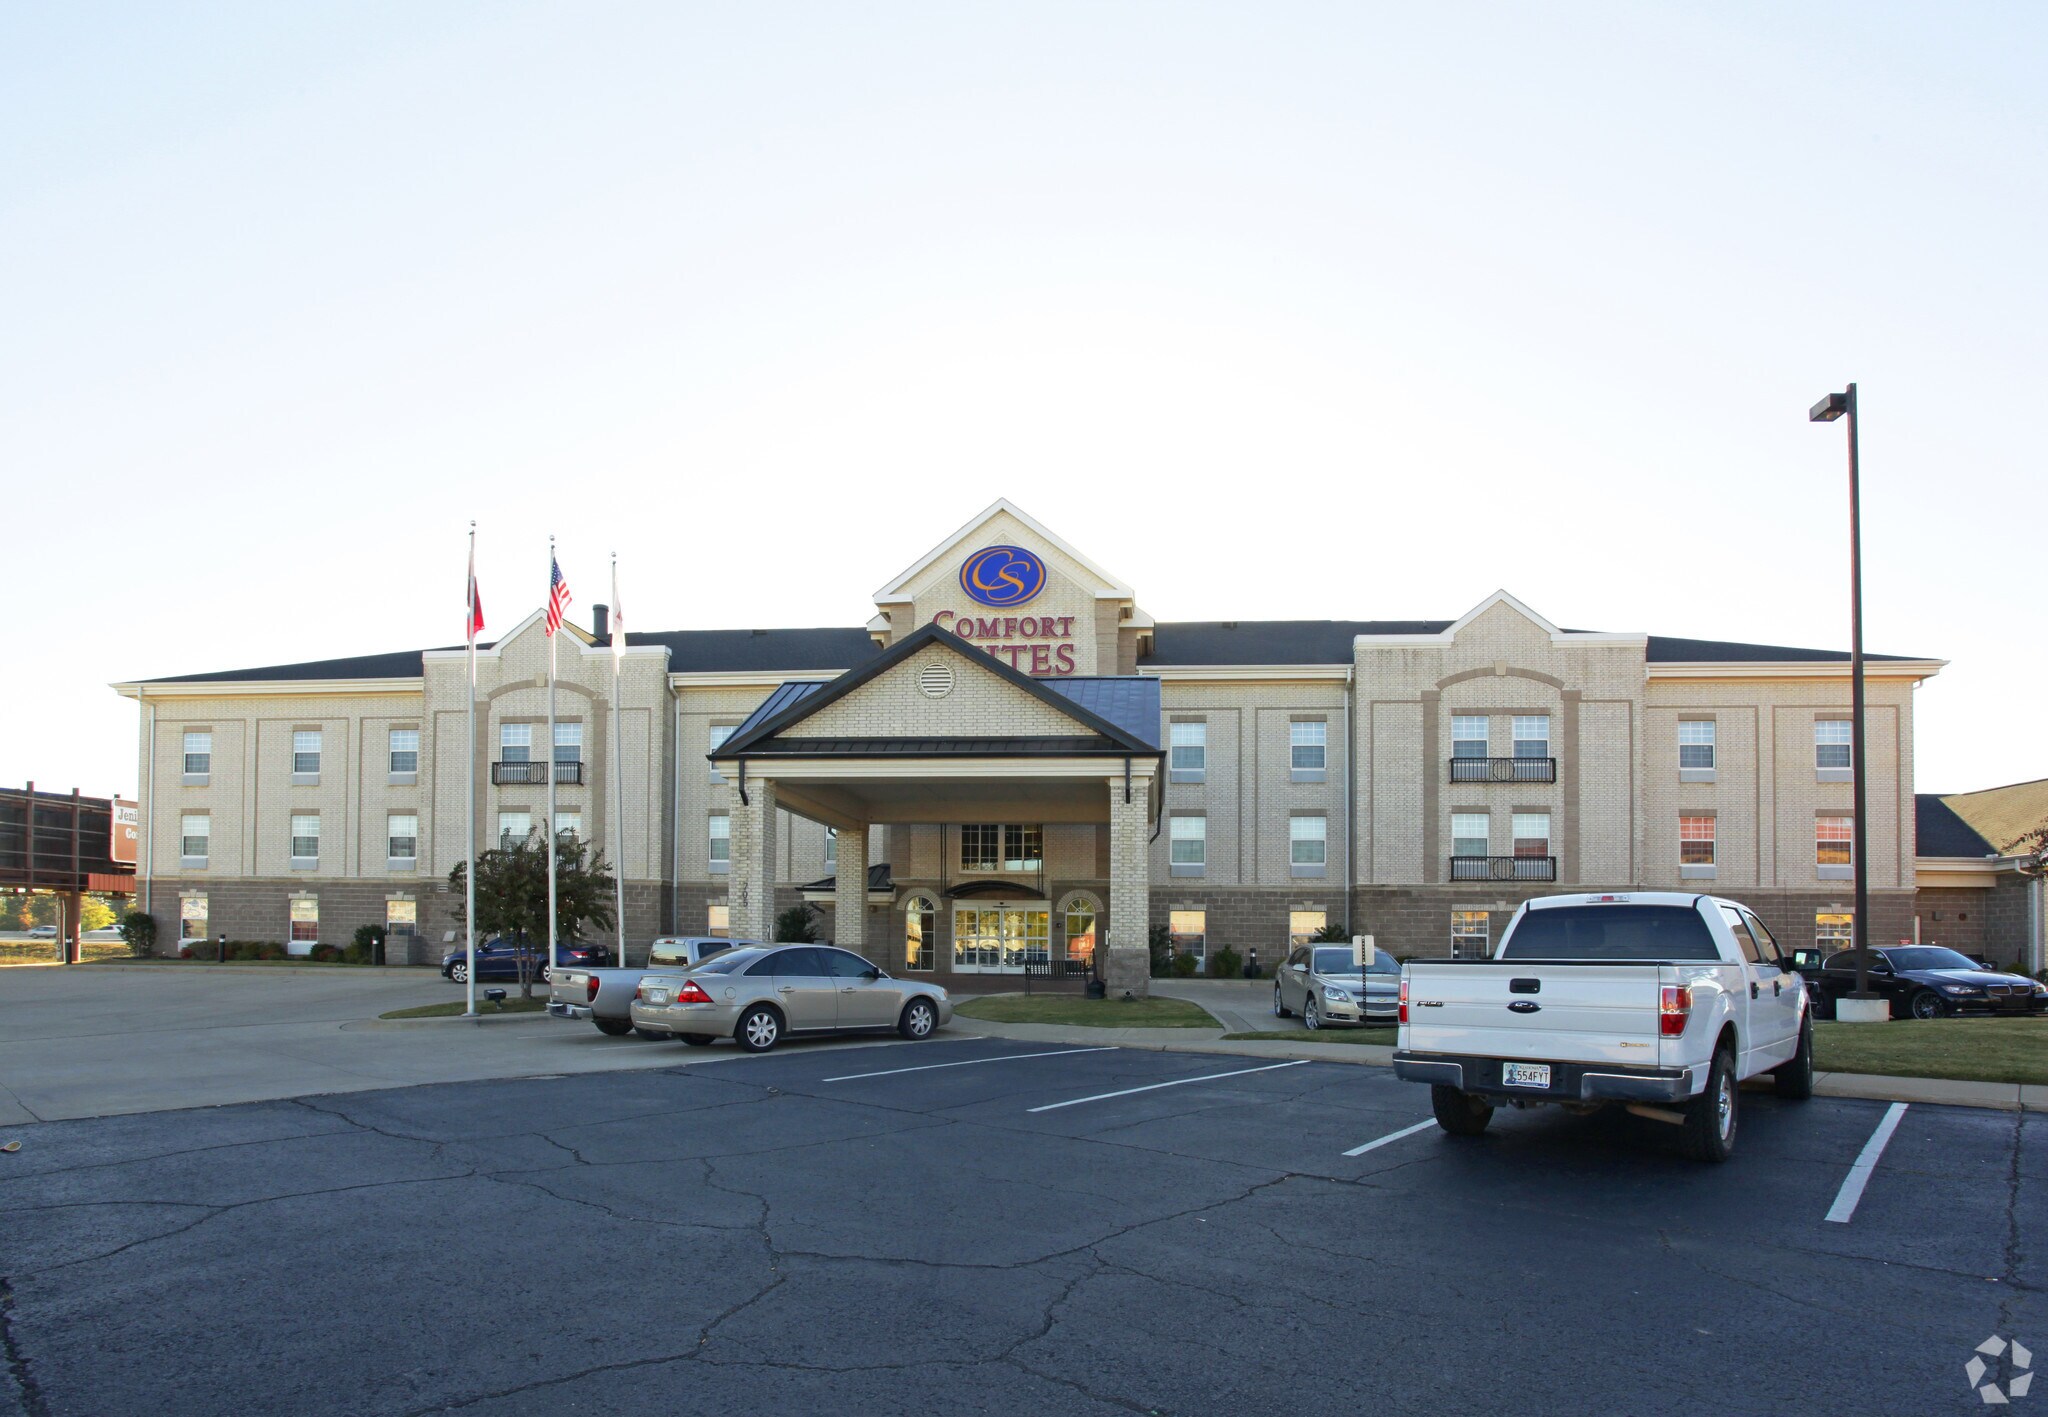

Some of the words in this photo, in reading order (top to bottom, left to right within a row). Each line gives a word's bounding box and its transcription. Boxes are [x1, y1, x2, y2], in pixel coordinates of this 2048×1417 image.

[932, 610, 1075, 639] COMFORT
[975, 643, 1075, 675] TES
[118, 808, 138, 822] Jeni
[1517, 1070, 1549, 1083] 554FYT
